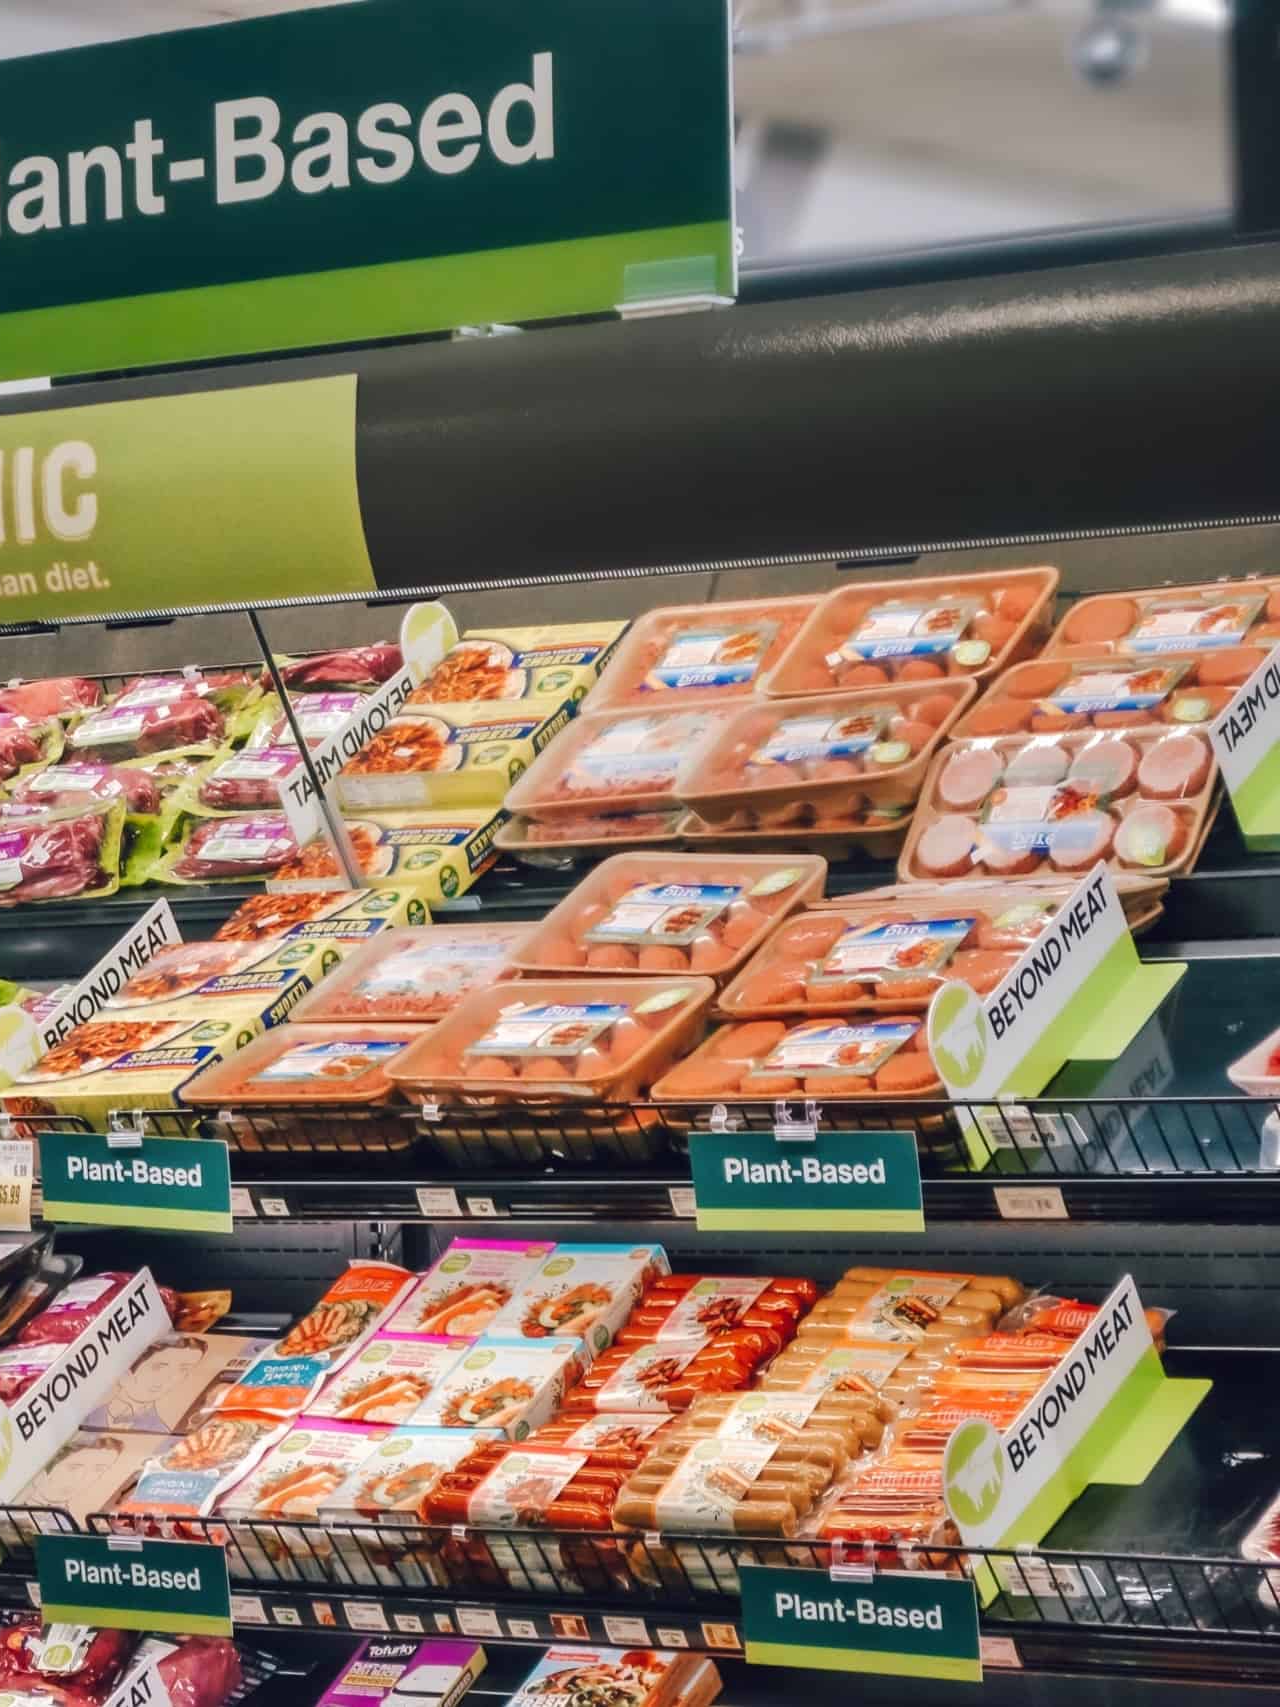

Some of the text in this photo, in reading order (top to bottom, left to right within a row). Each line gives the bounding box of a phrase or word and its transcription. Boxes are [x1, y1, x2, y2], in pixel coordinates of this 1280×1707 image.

[45, 561, 112, 593] diet.
[881, 924, 929, 939] pure
[987, 876, 1108, 1041] BEYOND MEAT
[43, 913, 168, 1049] BEYOND MEAT
[66, 1156, 203, 1188] Plant-Based
[723, 1157, 887, 1185] Plant-Based
[15, 1283, 153, 1442] BEYOND MEAT
[1006, 1294, 1135, 1473] BEYOND MEAT
[63, 1559, 202, 1592] Plant-Based
[774, 1592, 944, 1631] Plant-Based
[369, 1644, 417, 1657] Tofurky
